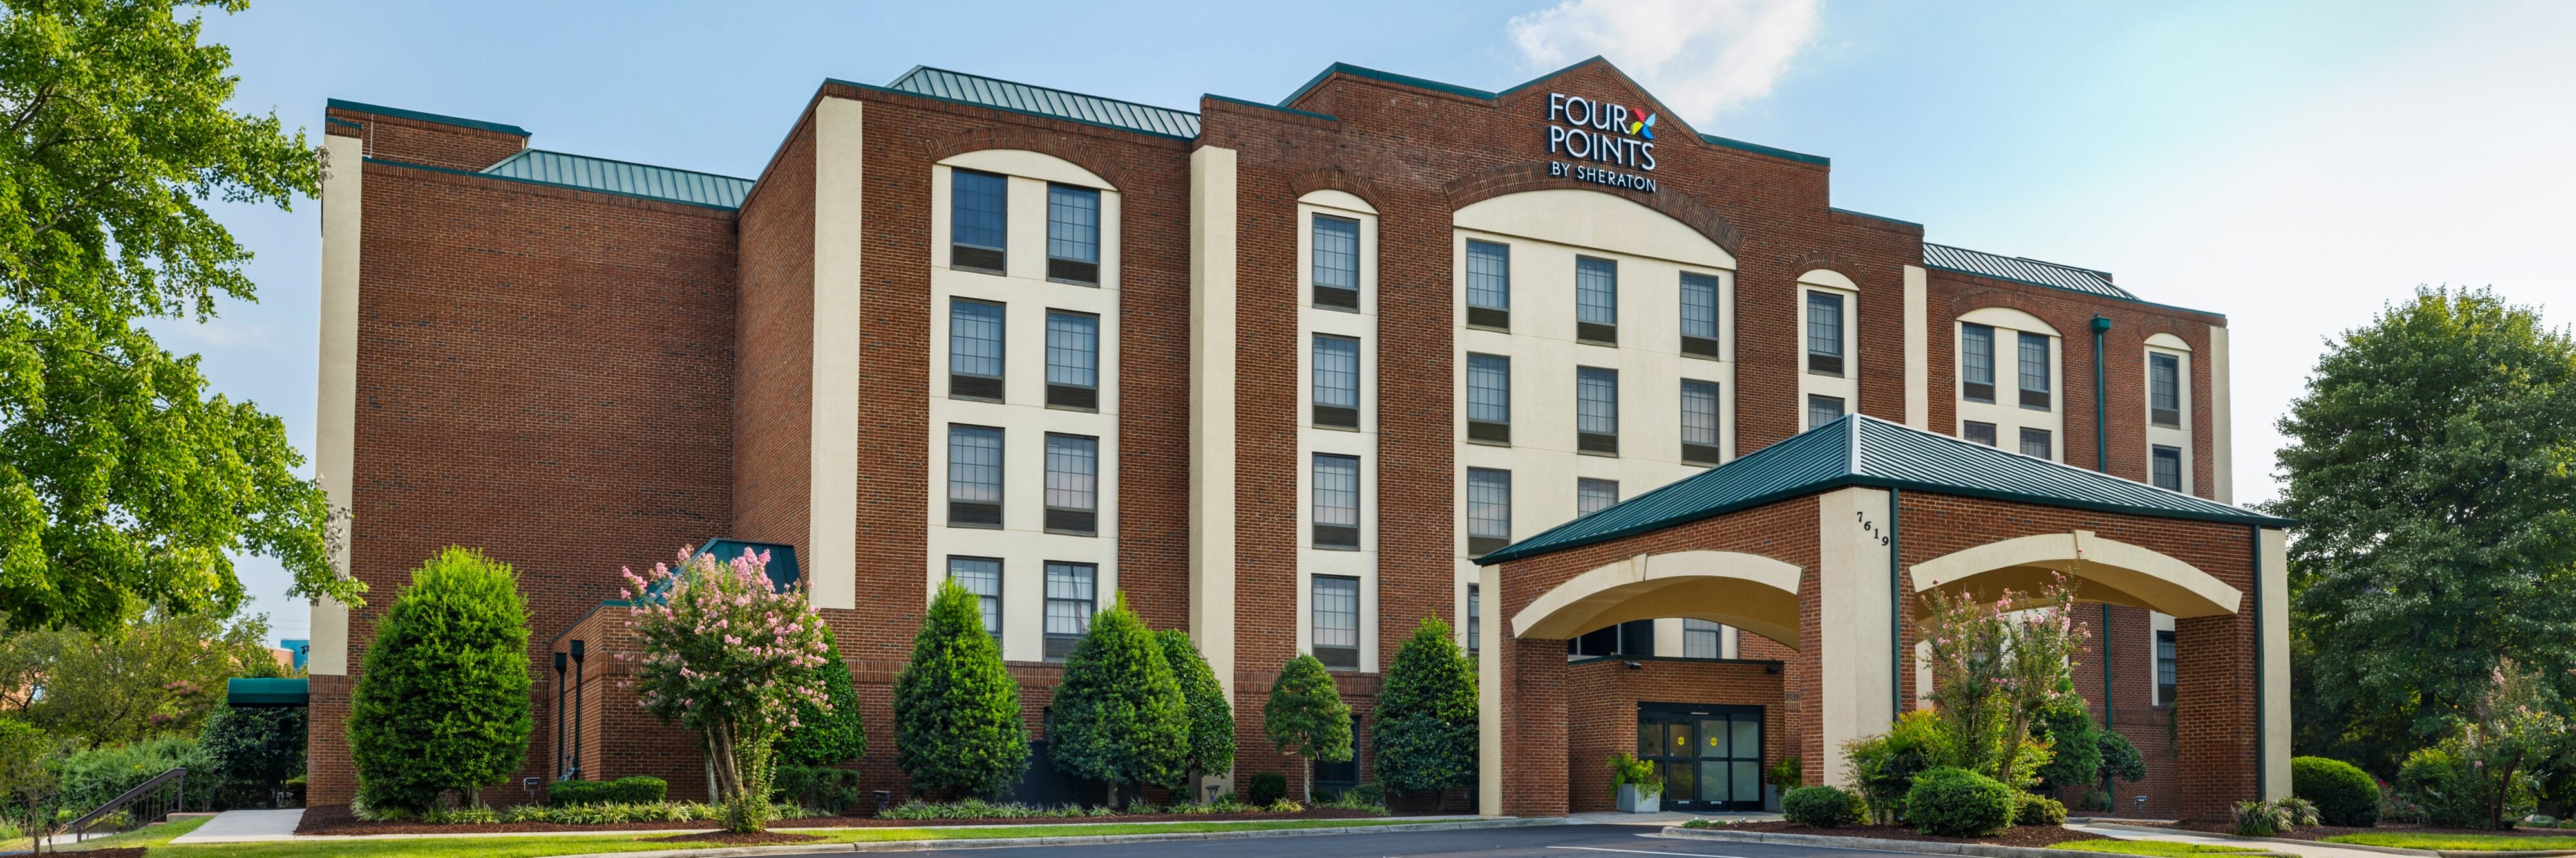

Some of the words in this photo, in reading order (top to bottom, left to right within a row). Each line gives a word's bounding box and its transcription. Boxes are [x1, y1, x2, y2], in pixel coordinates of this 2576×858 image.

[1549, 93, 1631, 134] FOUR
[1549, 125, 1656, 171] POINTS
[1551, 162, 1570, 177] BY
[1577, 165, 1656, 192] SHERATON
[1857, 511, 1889, 546] 7619
